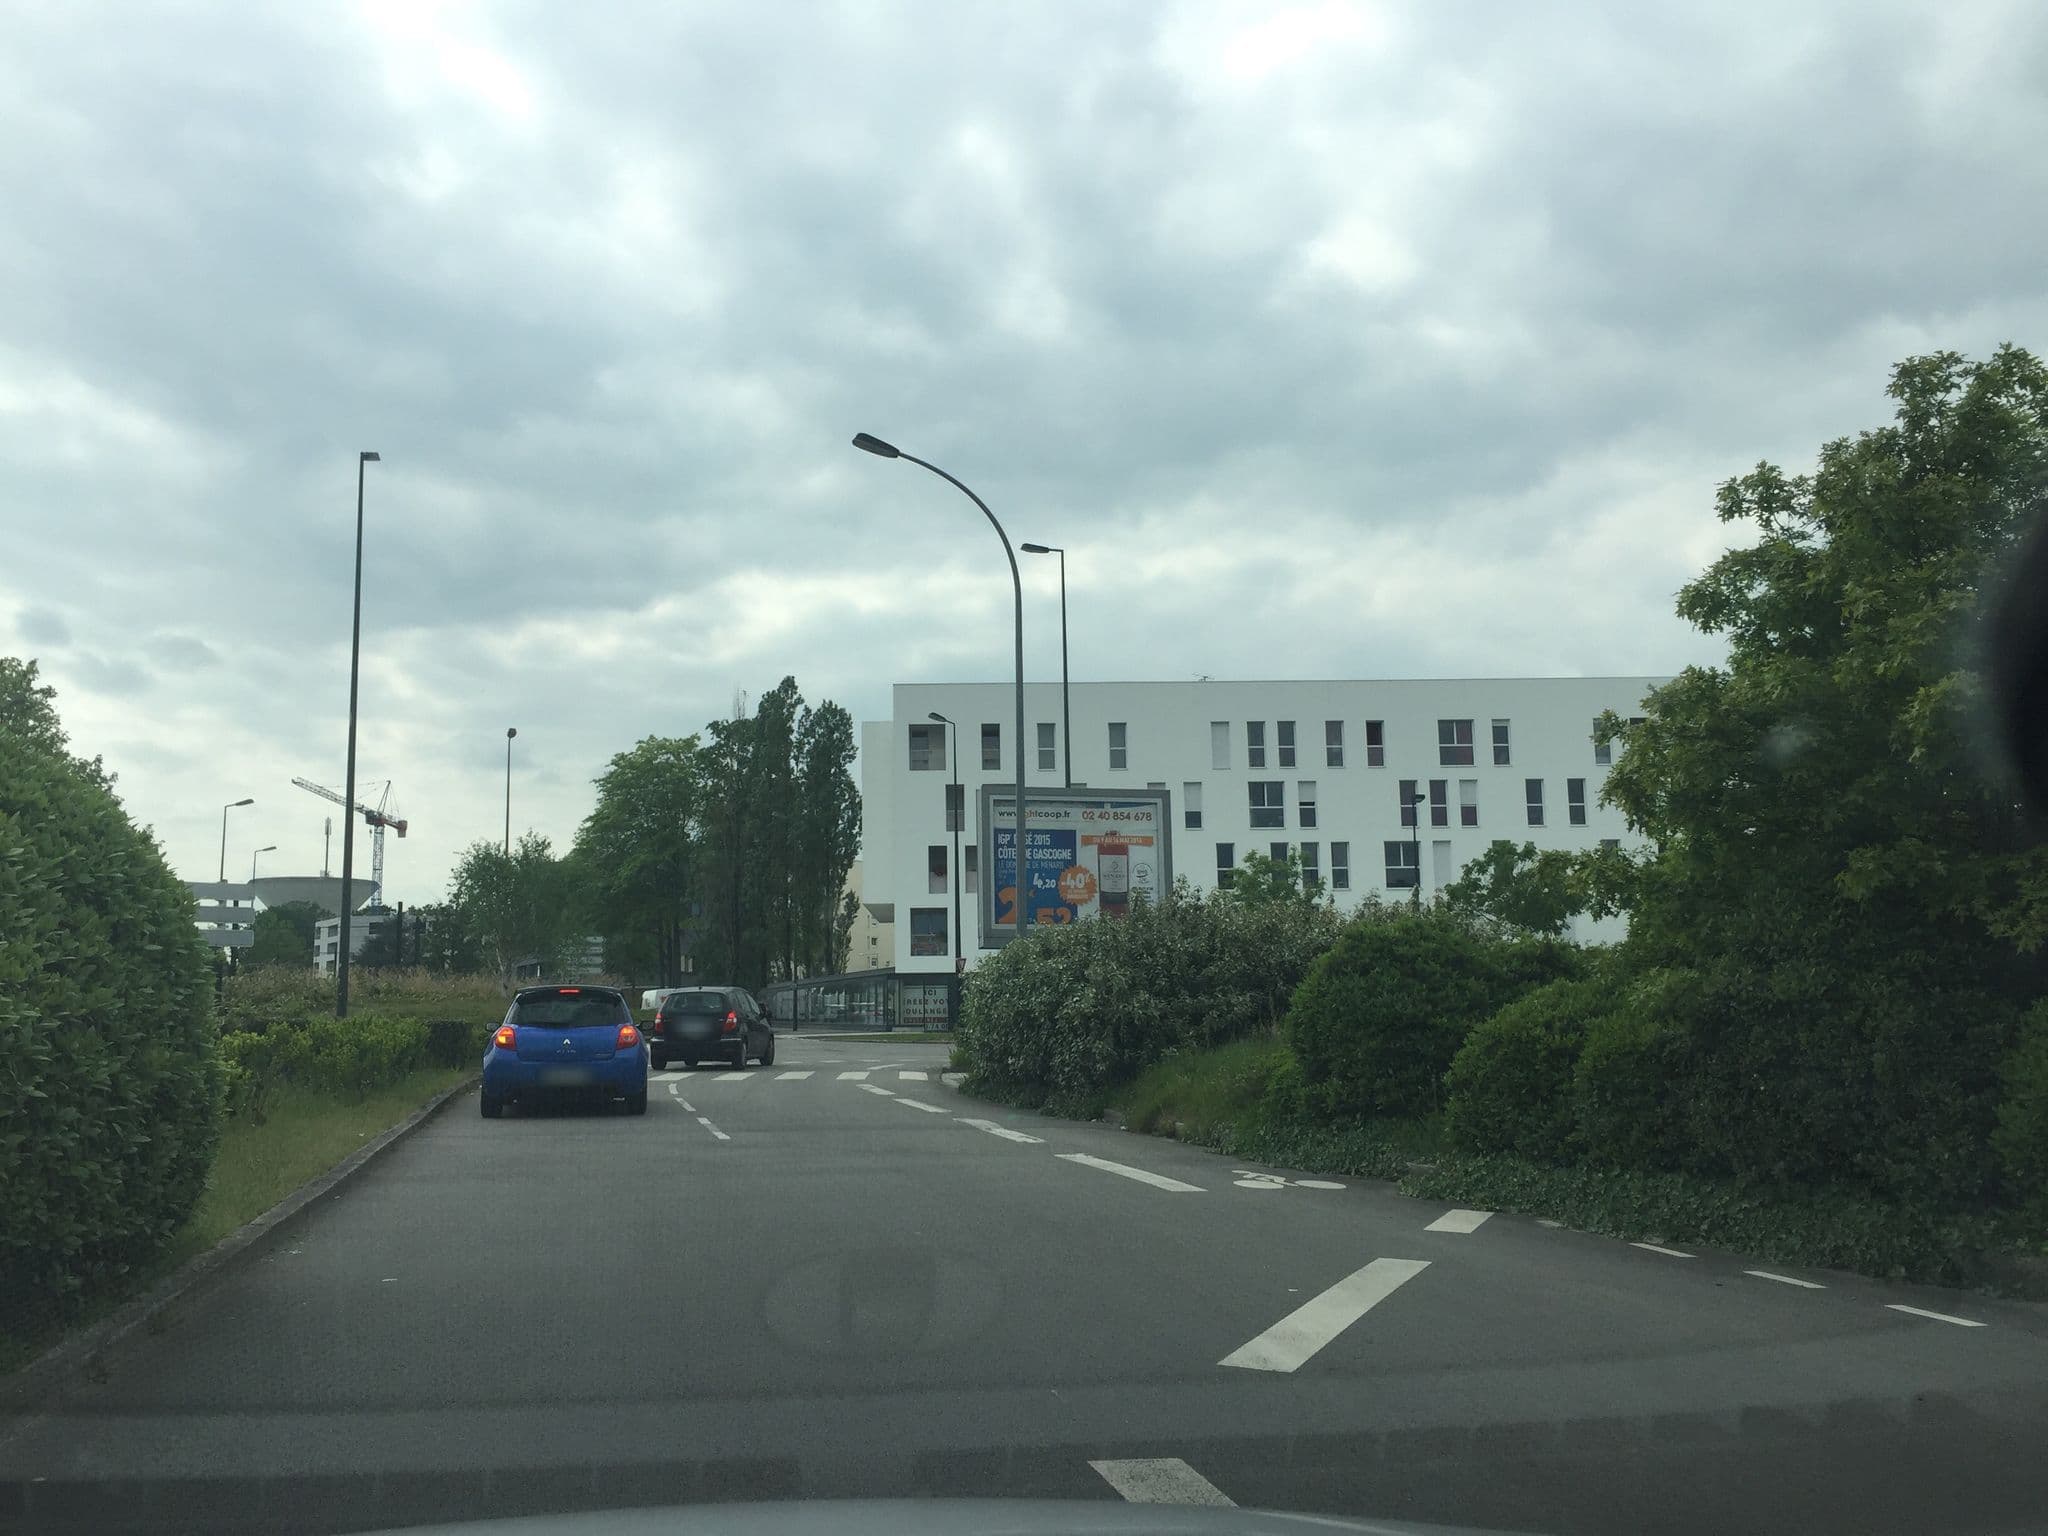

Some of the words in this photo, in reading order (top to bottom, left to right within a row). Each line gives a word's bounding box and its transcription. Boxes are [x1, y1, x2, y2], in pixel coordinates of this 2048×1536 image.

[1082, 811, 1094, 821] 02
[1097, 811, 1110, 821] 40
[1113, 811, 1131, 821] 854
[1134, 812, 1152, 822] 678
[1033, 834, 1051, 845] 2015
[1032, 848, 1072, 860] GASCOGNE
